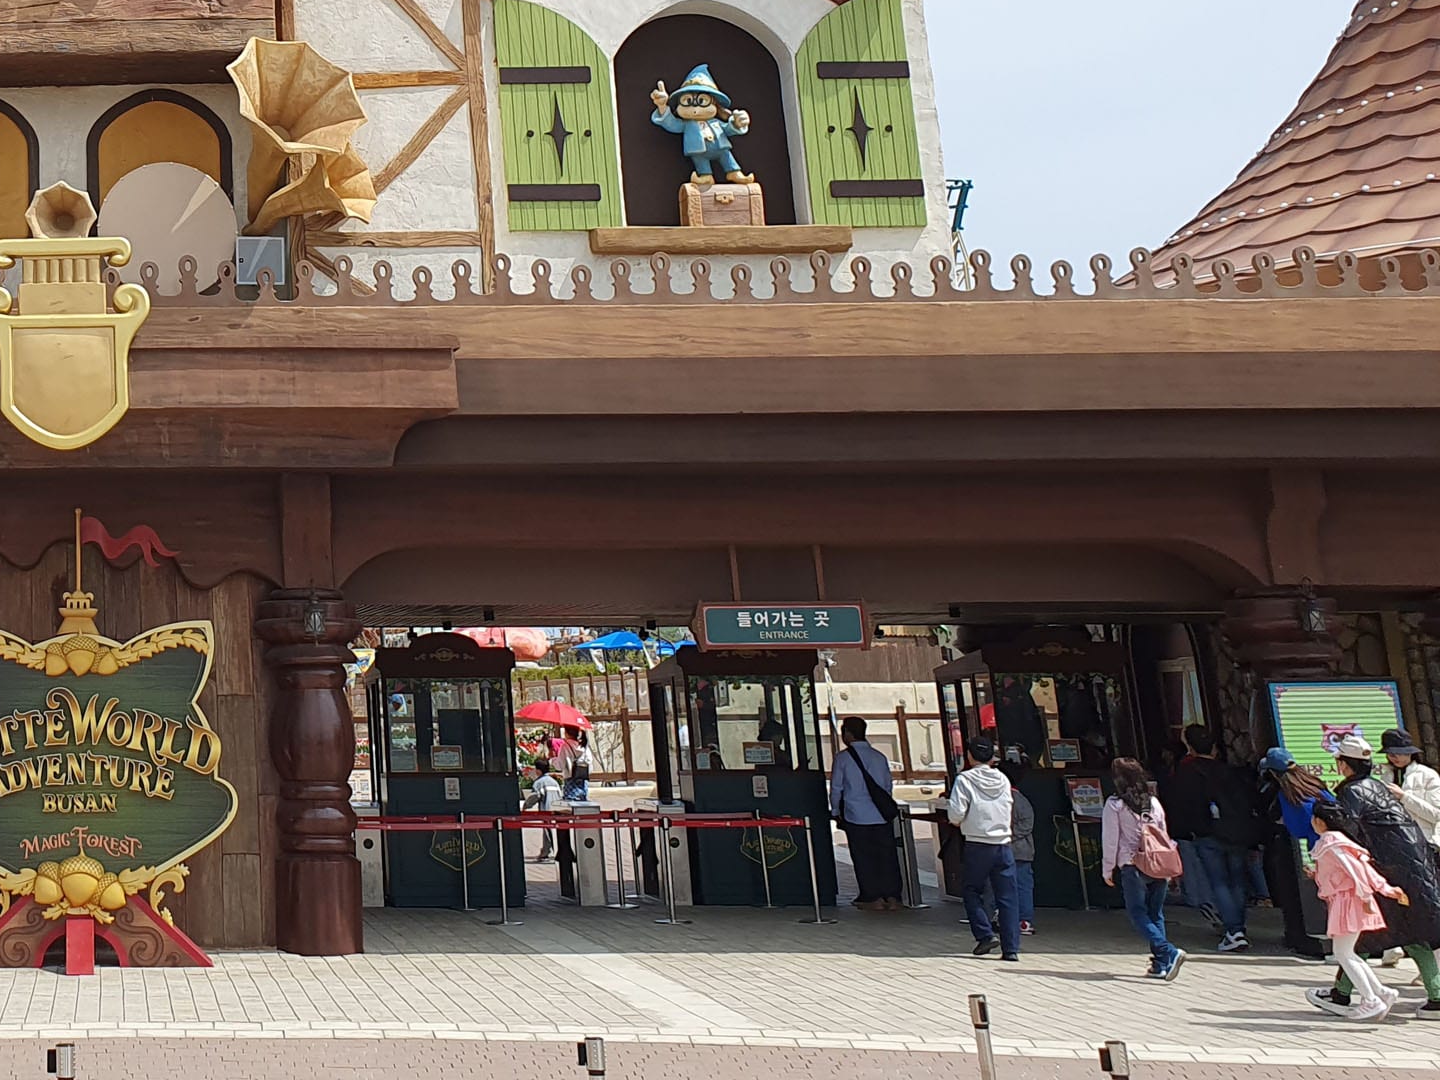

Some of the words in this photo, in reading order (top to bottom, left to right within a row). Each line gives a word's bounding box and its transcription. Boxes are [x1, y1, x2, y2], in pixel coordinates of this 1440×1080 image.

[736, 611, 804, 627] 들어가는
[814, 611, 830, 627] 곳
[759, 631, 809, 639] ENTRANCE
[46, 687, 221, 775] WORLD
[42, 793, 118, 814] BUSAN
[19, 832, 72, 858] MAGIC
[69, 826, 142, 857] FOREST
